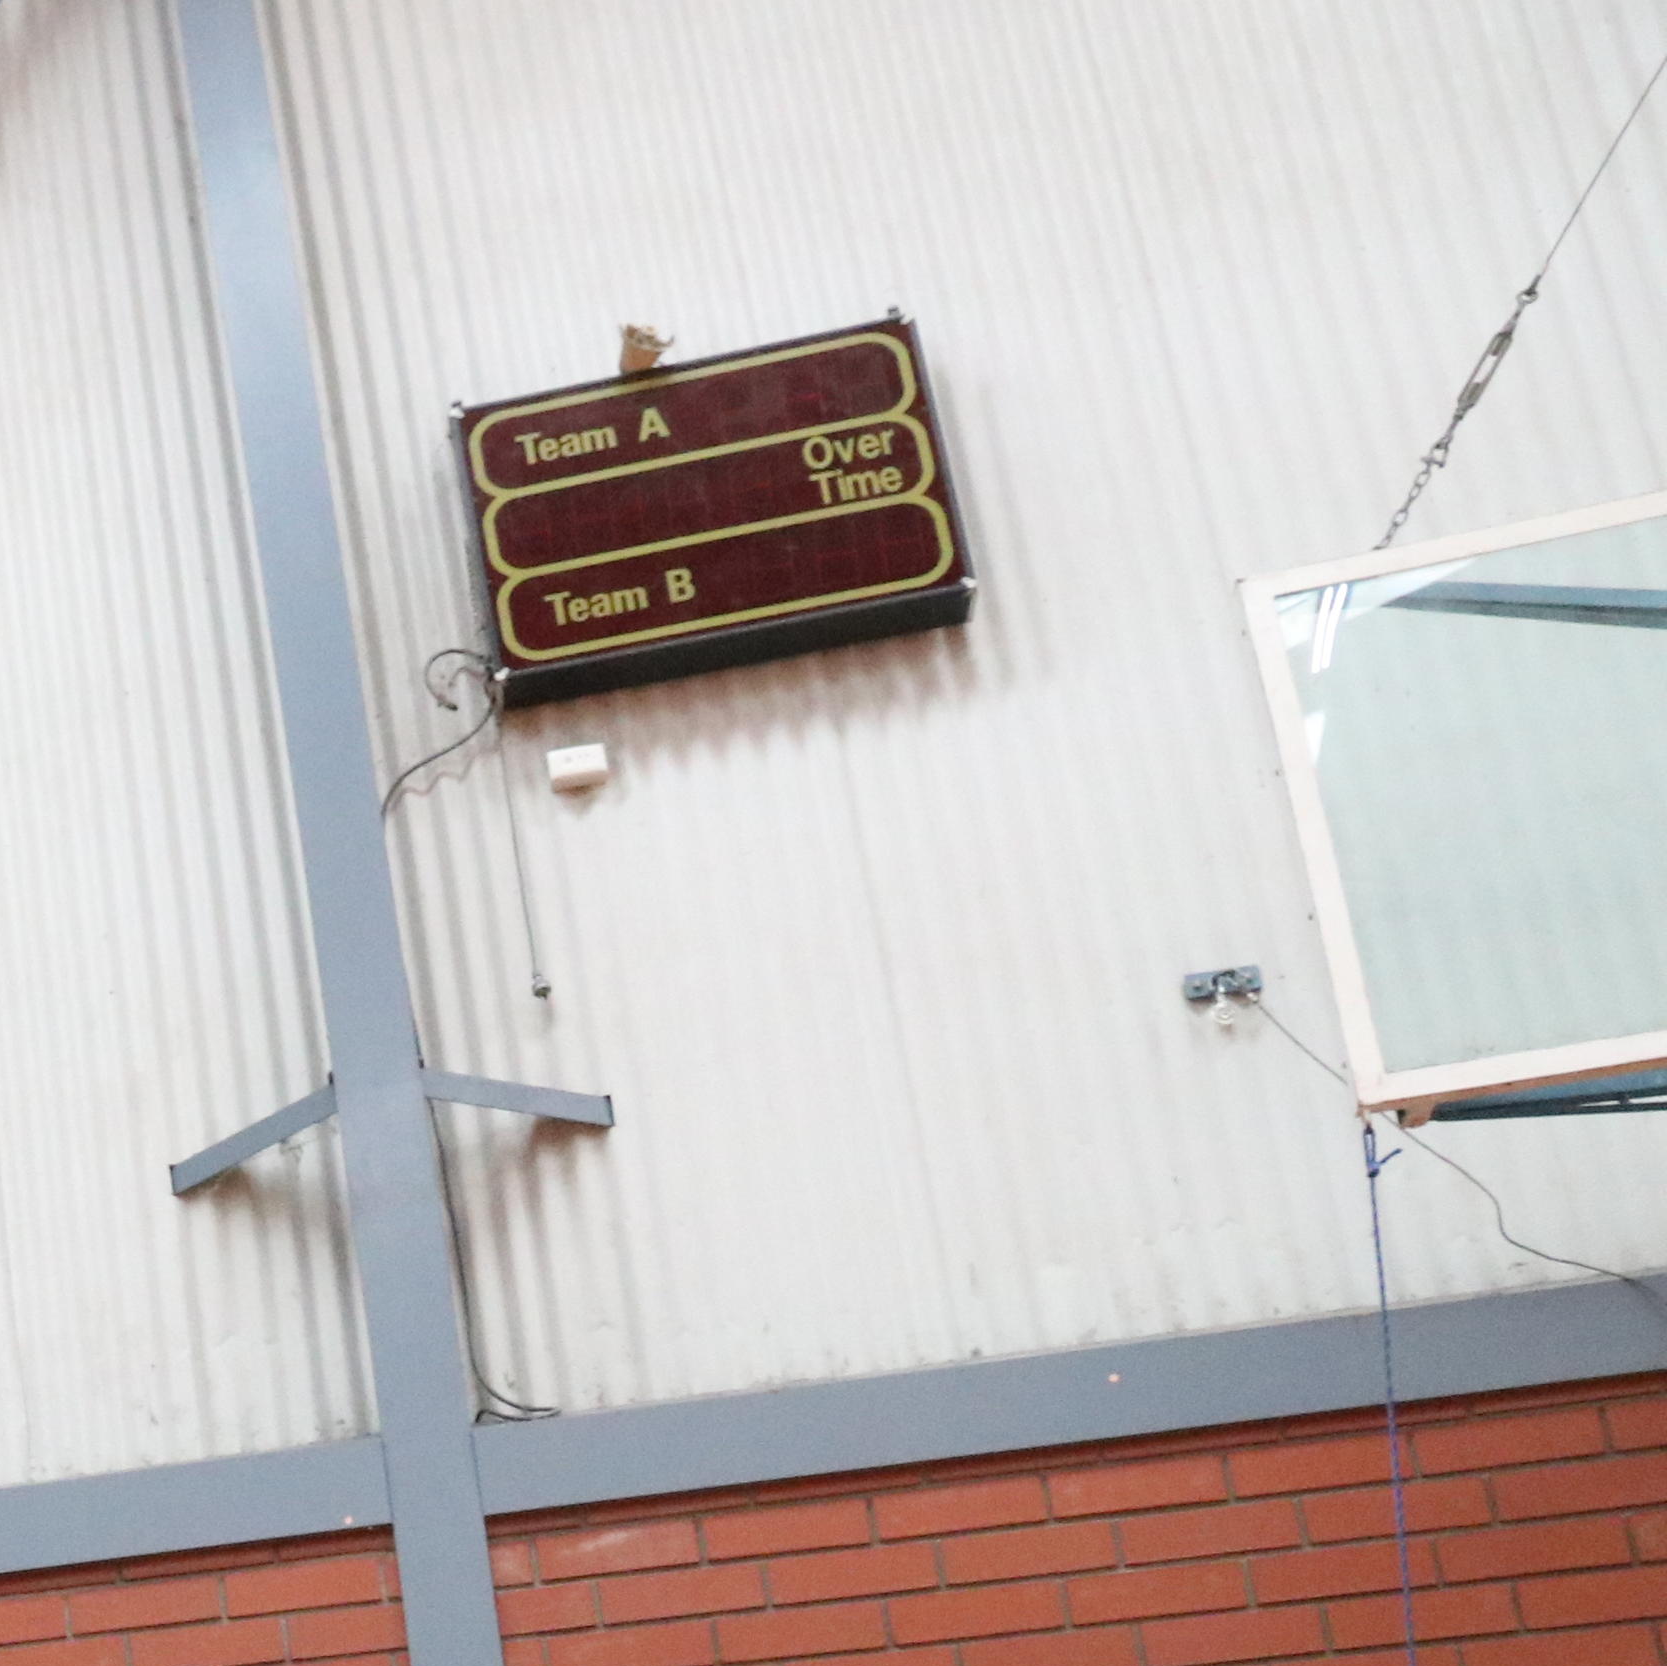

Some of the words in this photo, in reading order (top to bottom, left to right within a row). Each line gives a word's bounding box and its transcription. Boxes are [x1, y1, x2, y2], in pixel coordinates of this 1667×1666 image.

[514, 426, 617, 465] Team
[638, 407, 671, 442] A
[801, 428, 895, 469] Over
[809, 466, 903, 505] Time
[544, 585, 650, 627] Team
[665, 568, 696, 604] B
